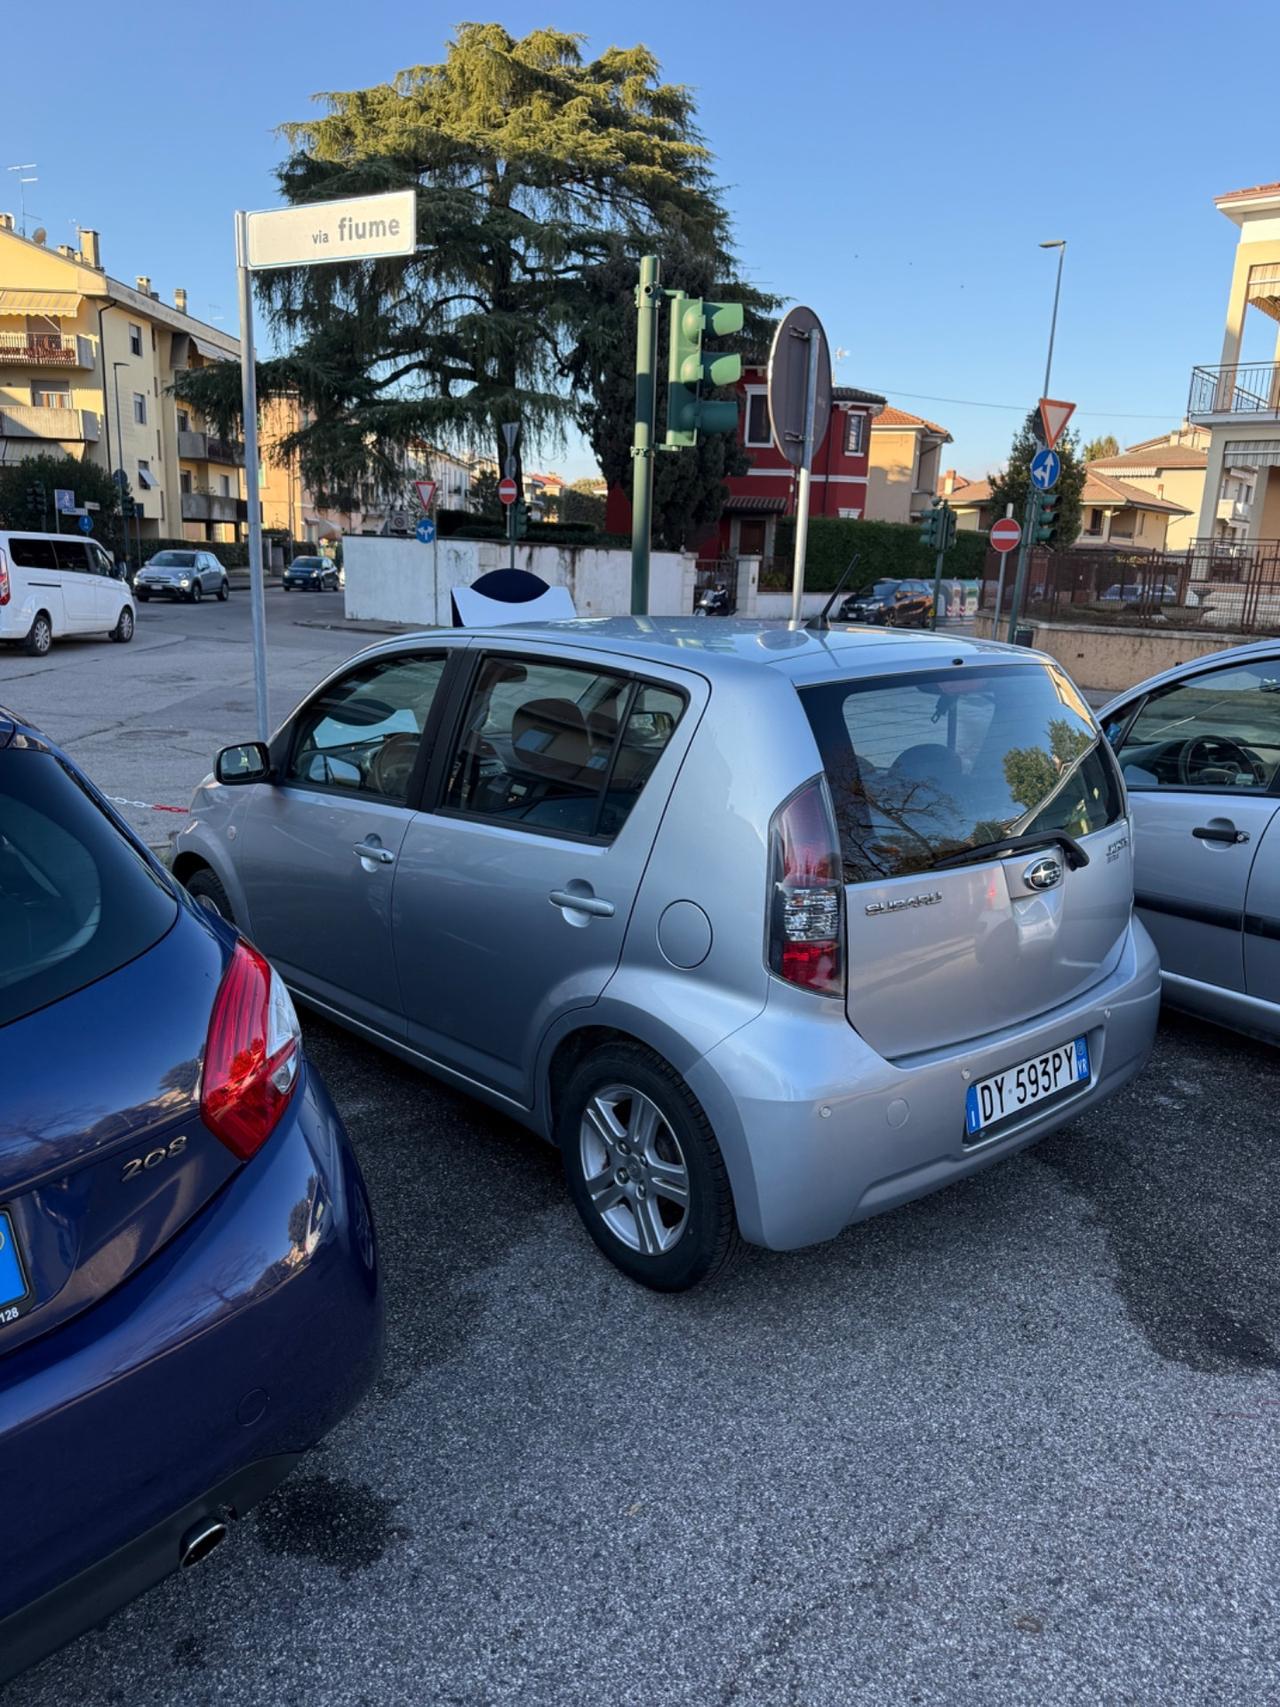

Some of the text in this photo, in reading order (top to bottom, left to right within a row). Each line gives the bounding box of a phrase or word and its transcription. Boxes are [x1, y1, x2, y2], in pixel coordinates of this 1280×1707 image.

[312, 217, 400, 244] via fiume
[865, 891, 943, 914] SUBARU
[980, 1076, 1005, 1122] DY
[1016, 1046, 1074, 1104] 593PY
[120, 1135, 187, 1184] 208
[0, 1306, 19, 1323] 128
